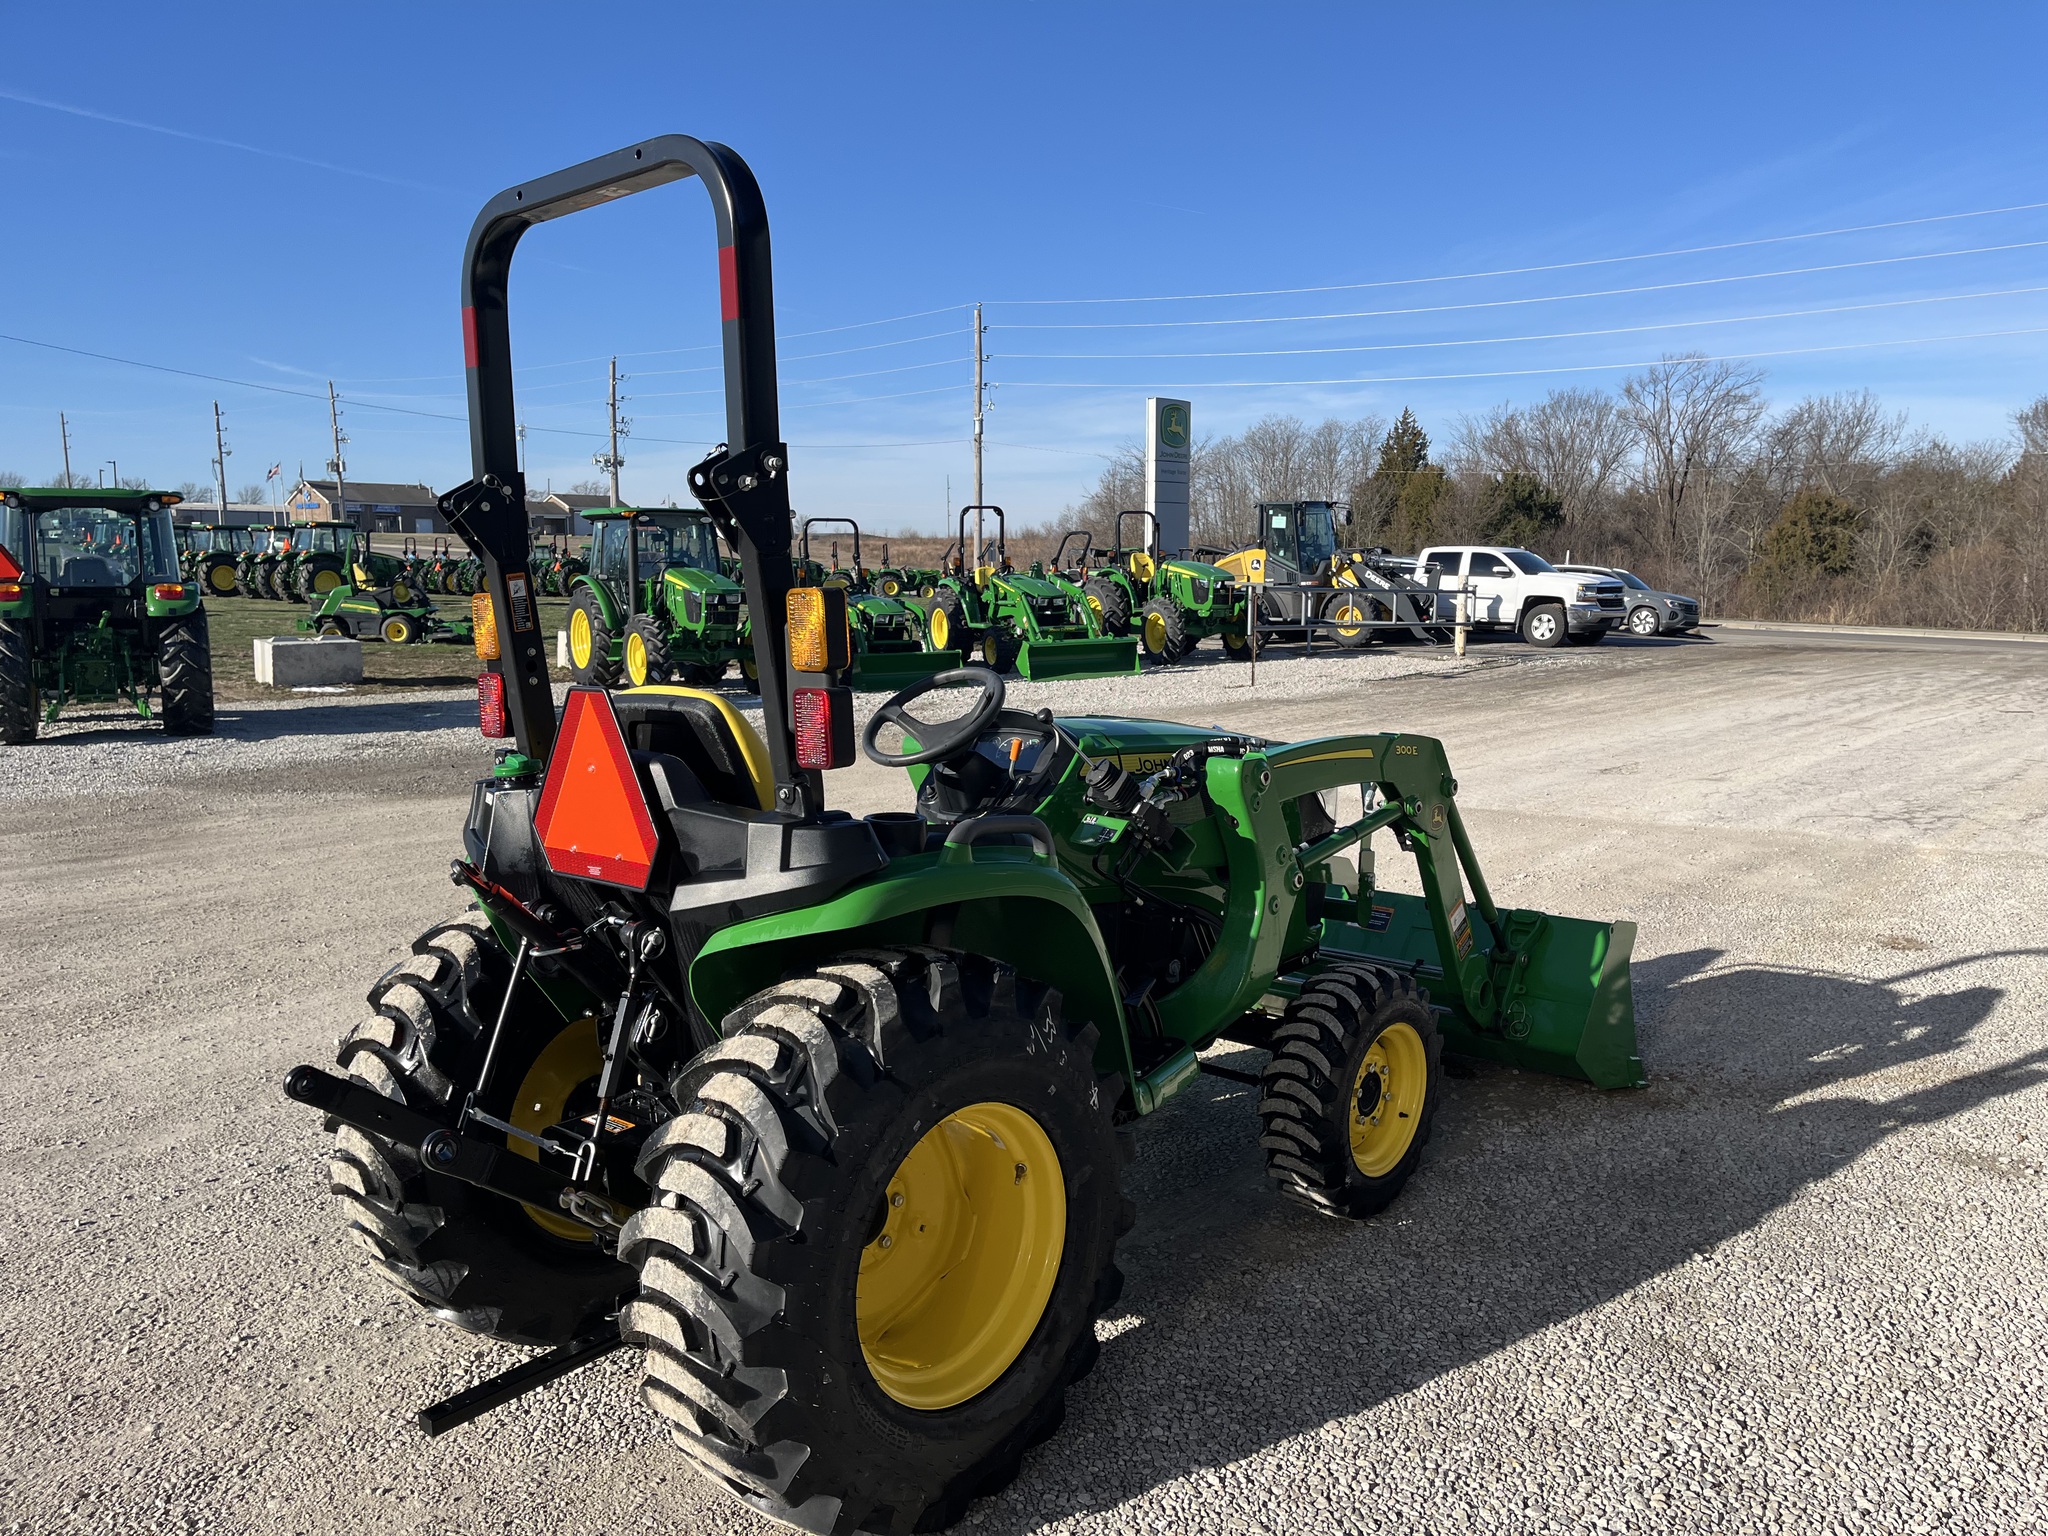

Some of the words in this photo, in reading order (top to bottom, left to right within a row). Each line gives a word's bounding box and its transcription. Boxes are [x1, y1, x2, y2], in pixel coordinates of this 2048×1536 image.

[1365, 570, 1391, 590] DEERE
[1207, 745, 1225, 753] MSHA
[1395, 745, 1418, 755] 300E
